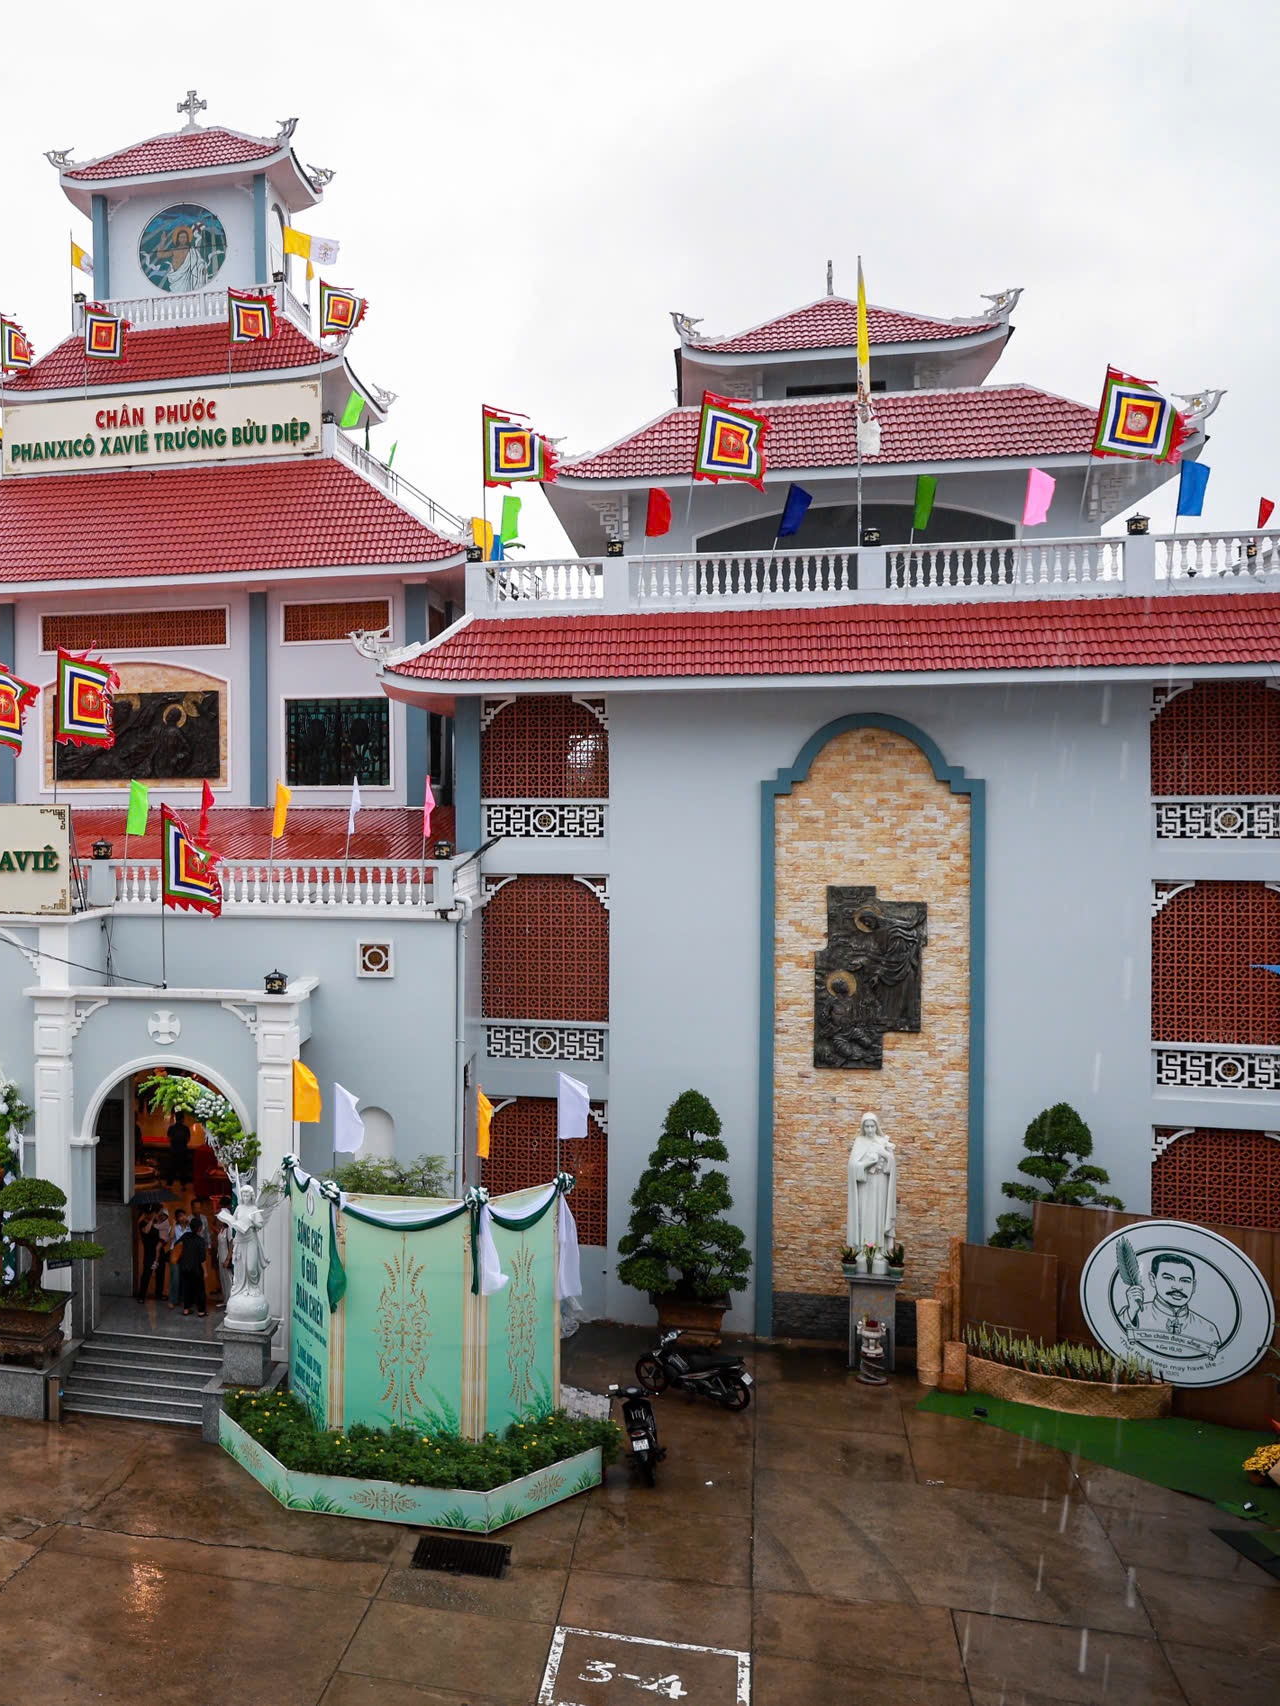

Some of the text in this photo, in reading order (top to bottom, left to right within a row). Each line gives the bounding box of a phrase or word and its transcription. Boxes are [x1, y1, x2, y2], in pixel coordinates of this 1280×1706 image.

[95, 397, 216, 429] CHÂN PHƯỚC
[11, 417, 311, 462] PHANXICÔ XAVIÊ TRƯƠNG BỬU DIỆP
[1170, 1364, 1185, 1372] may
